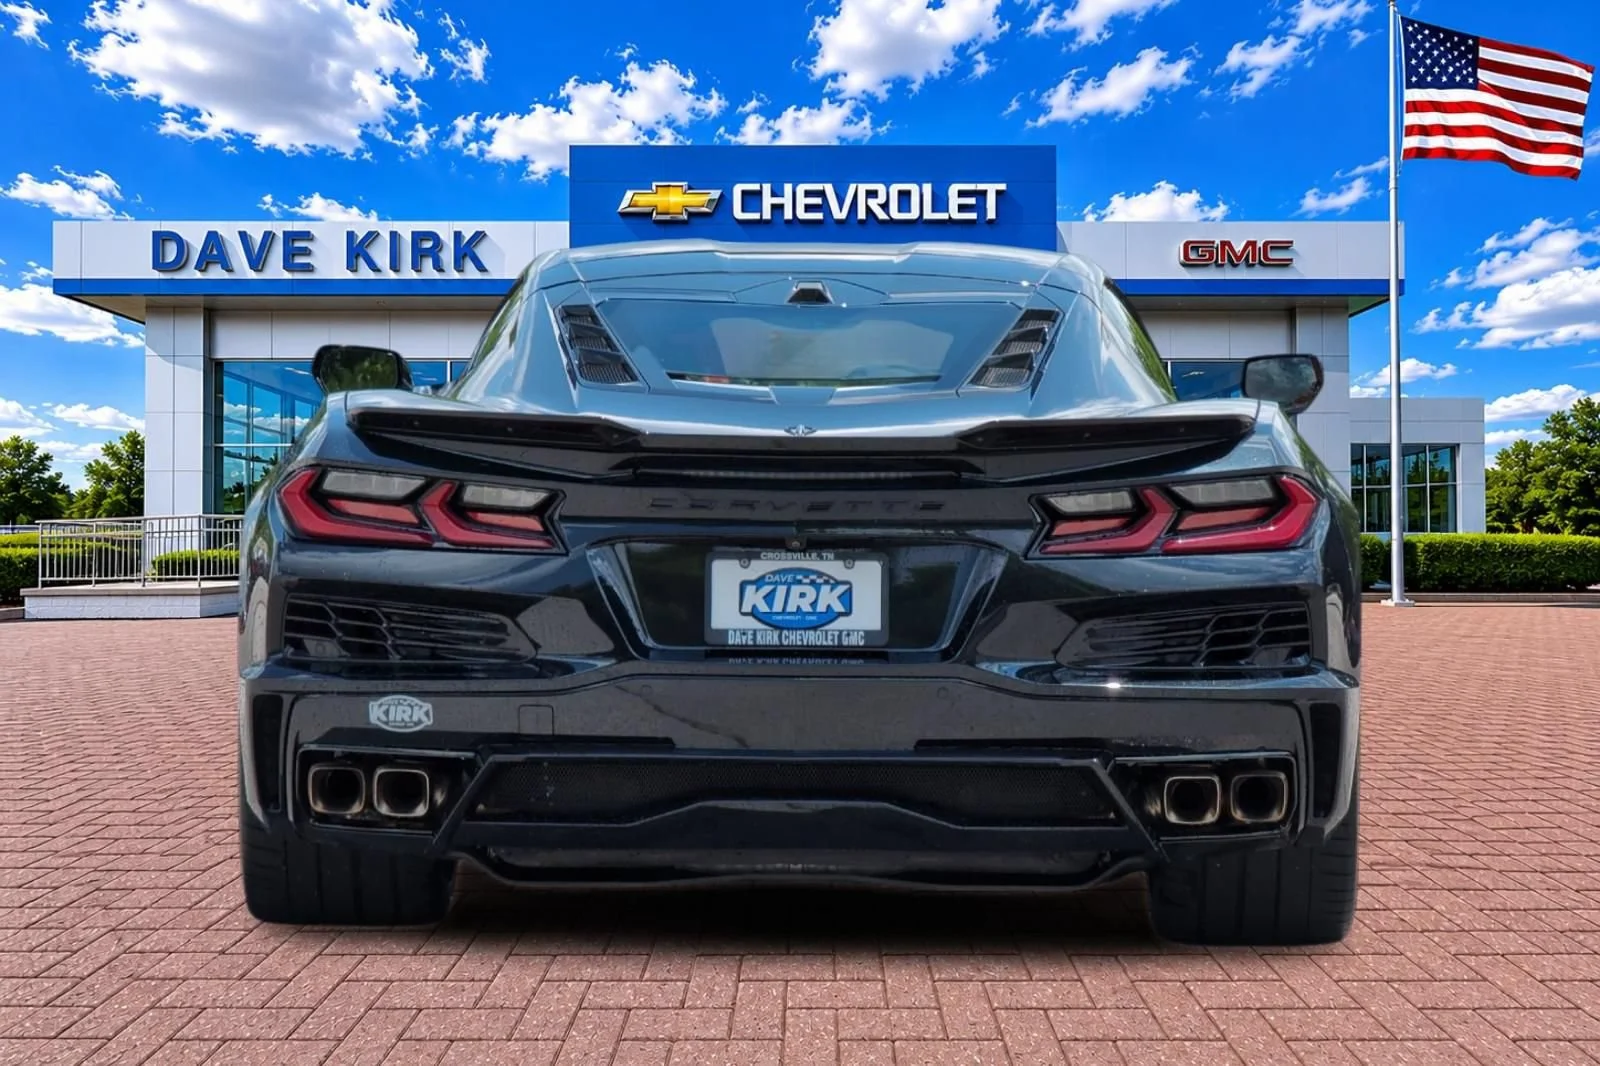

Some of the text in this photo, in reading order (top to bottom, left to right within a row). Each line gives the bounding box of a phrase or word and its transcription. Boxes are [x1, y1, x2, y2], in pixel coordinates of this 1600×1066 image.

[732, 182, 1007, 223] CHEVROLET
[151, 230, 489, 273] DAVE KIRK
[1179, 239, 1294, 267] GMC
[760, 552, 834, 561] CROSSVILLE, TN
[765, 574, 796, 583] DAVE
[741, 584, 850, 613] KIRK
[728, 630, 864, 646] DAVE KIRK CHEVROLET GMC
[371, 704, 429, 722] KIRK
